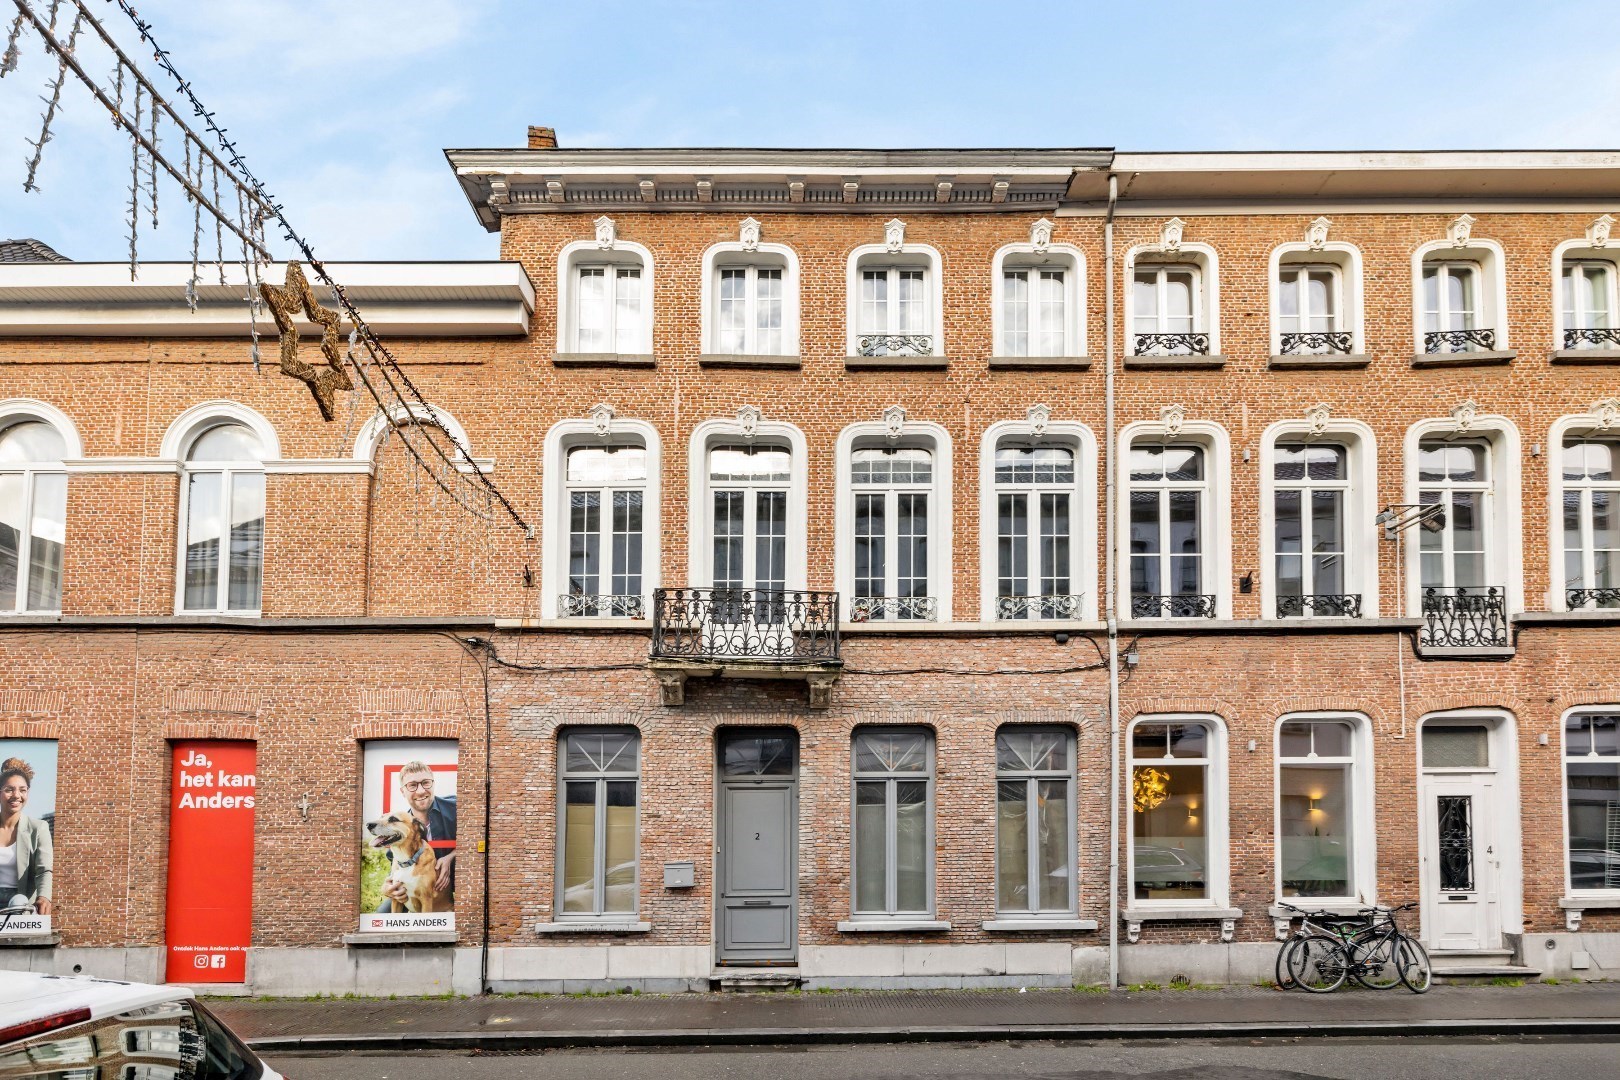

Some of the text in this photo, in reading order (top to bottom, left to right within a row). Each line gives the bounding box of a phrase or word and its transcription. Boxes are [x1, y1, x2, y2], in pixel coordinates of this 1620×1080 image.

[180, 750, 212, 768] Ja,
[180, 770, 256, 788] het kan
[178, 792, 255, 808] Anders
[755, 832, 760, 840] 2
[1486, 846, 1492, 854] 4
[412, 918, 447, 926] ANDERS
